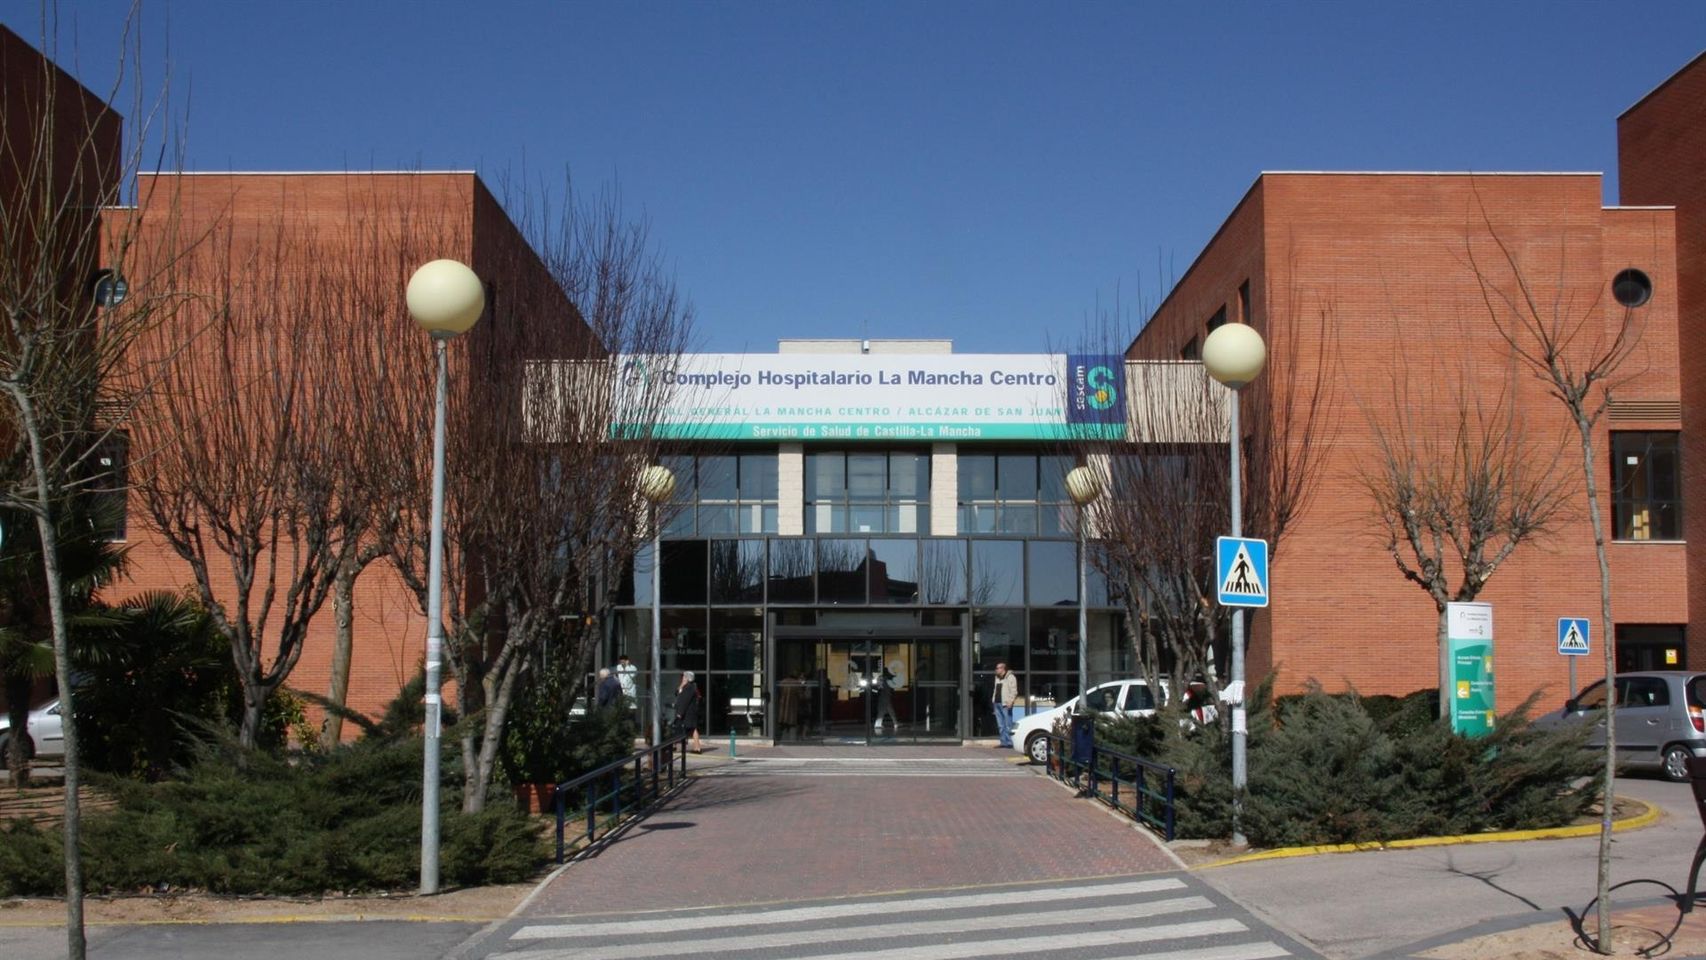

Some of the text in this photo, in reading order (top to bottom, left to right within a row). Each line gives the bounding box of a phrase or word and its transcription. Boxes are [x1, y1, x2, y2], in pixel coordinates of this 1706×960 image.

[662, 370, 1057, 389] Complejo Hospitalario La Mancha Centro
[1076, 365, 1085, 410] sescam
[691, 407, 749, 417] GENERAL
[755, 407, 771, 416] LA
[777, 407, 833, 416] MANCHA
[838, 406, 890, 416] CENTRO
[908, 404, 970, 416] ALCÁZAR
[975, 407, 993, 416] DE
[1000, 407, 1024, 416] SAN
[1030, 407, 1063, 417] JUAN
[752, 424, 982, 437] Servicio de Salud de Castilla-La Mancha
